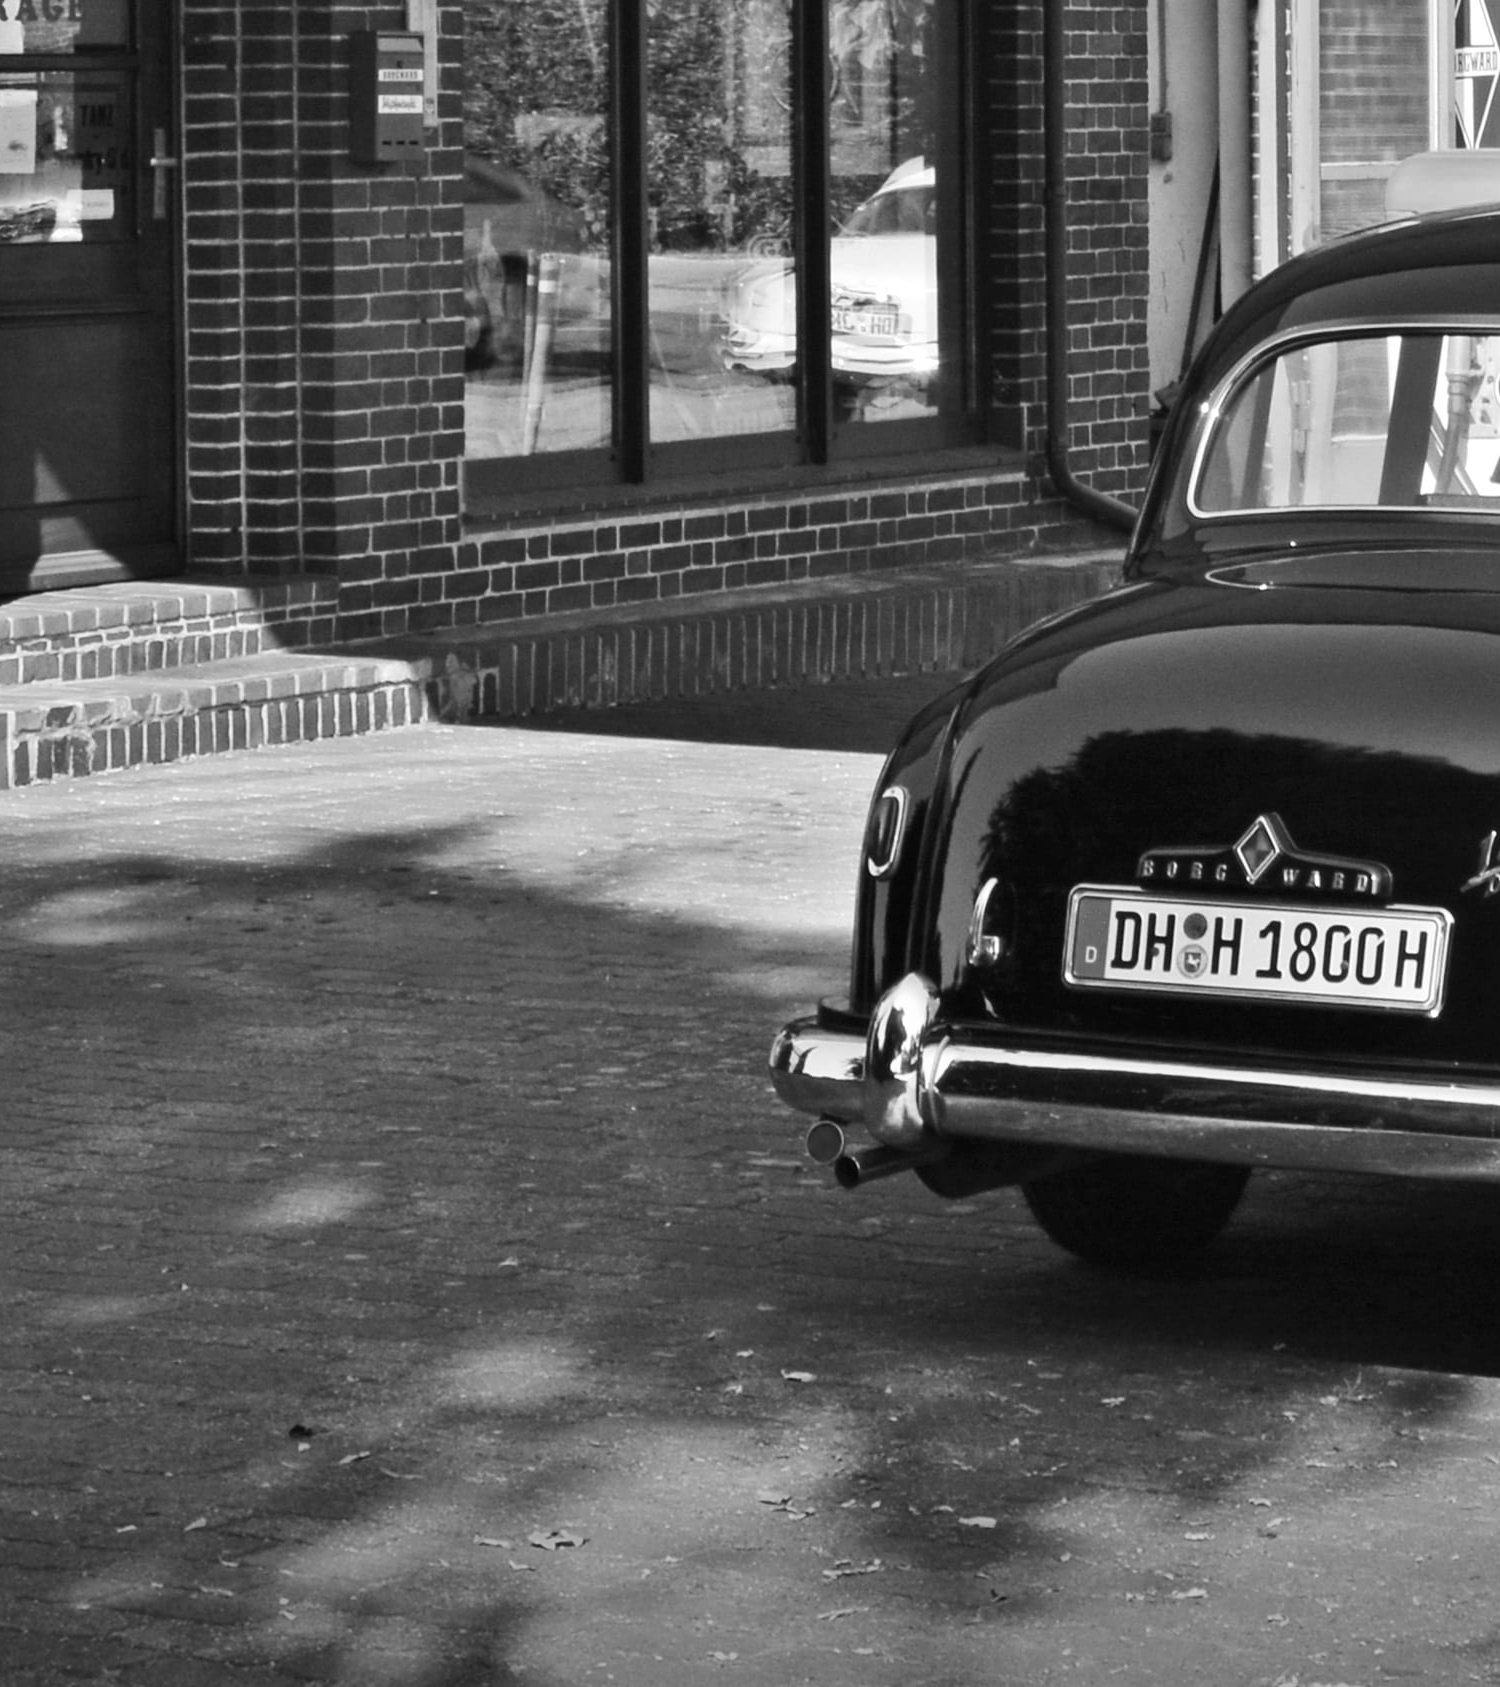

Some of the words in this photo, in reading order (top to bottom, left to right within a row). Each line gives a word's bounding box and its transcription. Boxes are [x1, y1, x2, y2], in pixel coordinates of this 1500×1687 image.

[1141, 858, 1228, 882] BORG
[1282, 868, 1380, 896] WARD
[1084, 946, 1098, 964] D
[1110, 911, 1176, 972] DH
